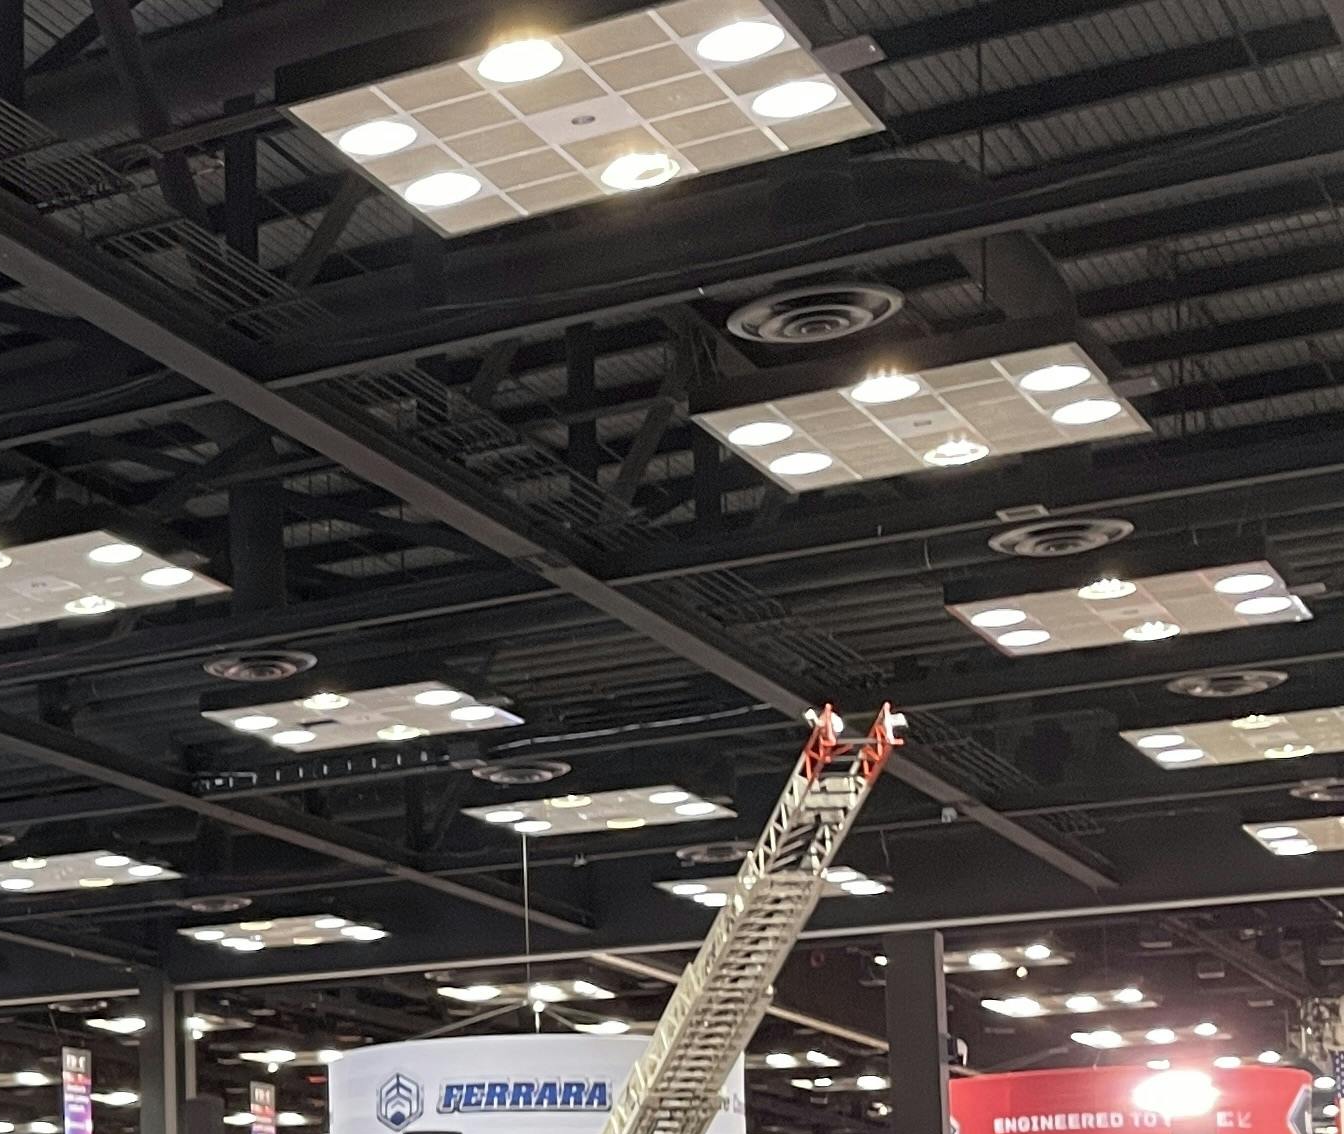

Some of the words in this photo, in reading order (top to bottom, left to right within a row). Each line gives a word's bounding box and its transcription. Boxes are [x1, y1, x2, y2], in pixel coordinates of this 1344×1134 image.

[441, 1080, 610, 1111] FERRARA
[993, 1112, 1124, 1134] ENGINEERED
[1129, 1111, 1156, 1129] TO
